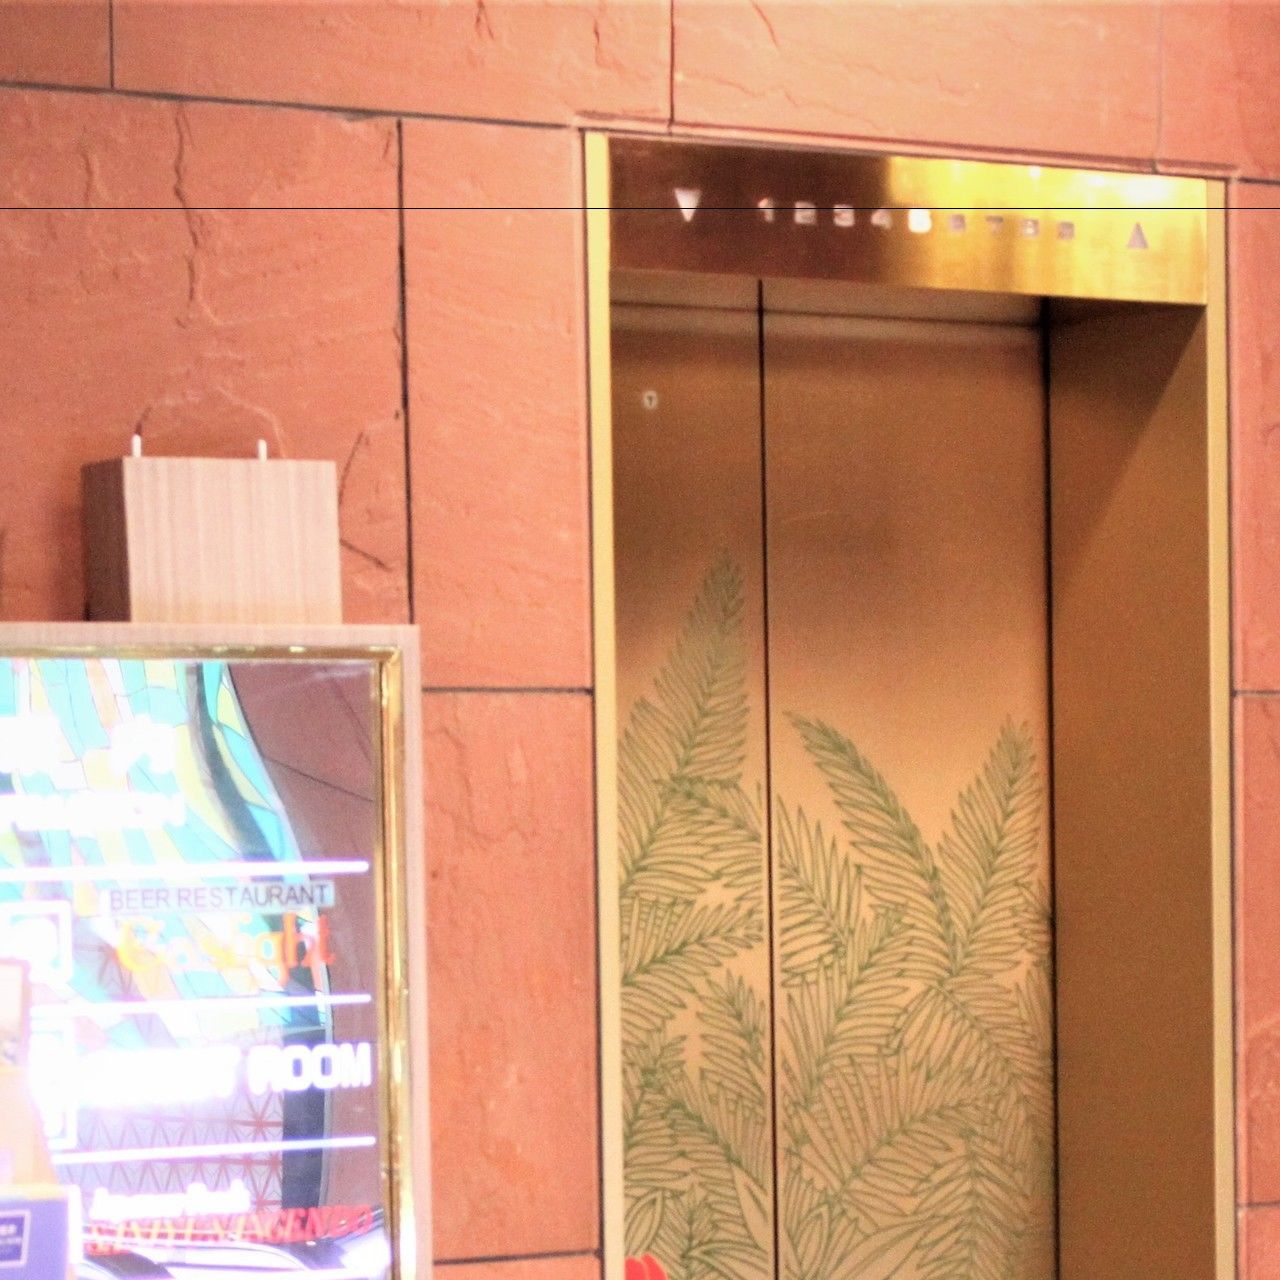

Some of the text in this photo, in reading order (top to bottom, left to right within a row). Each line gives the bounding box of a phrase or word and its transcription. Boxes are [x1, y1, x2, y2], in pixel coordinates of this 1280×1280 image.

[109, 883, 329, 911] BEER RESTAURANT
[247, 1041, 372, 1096] ROOM
